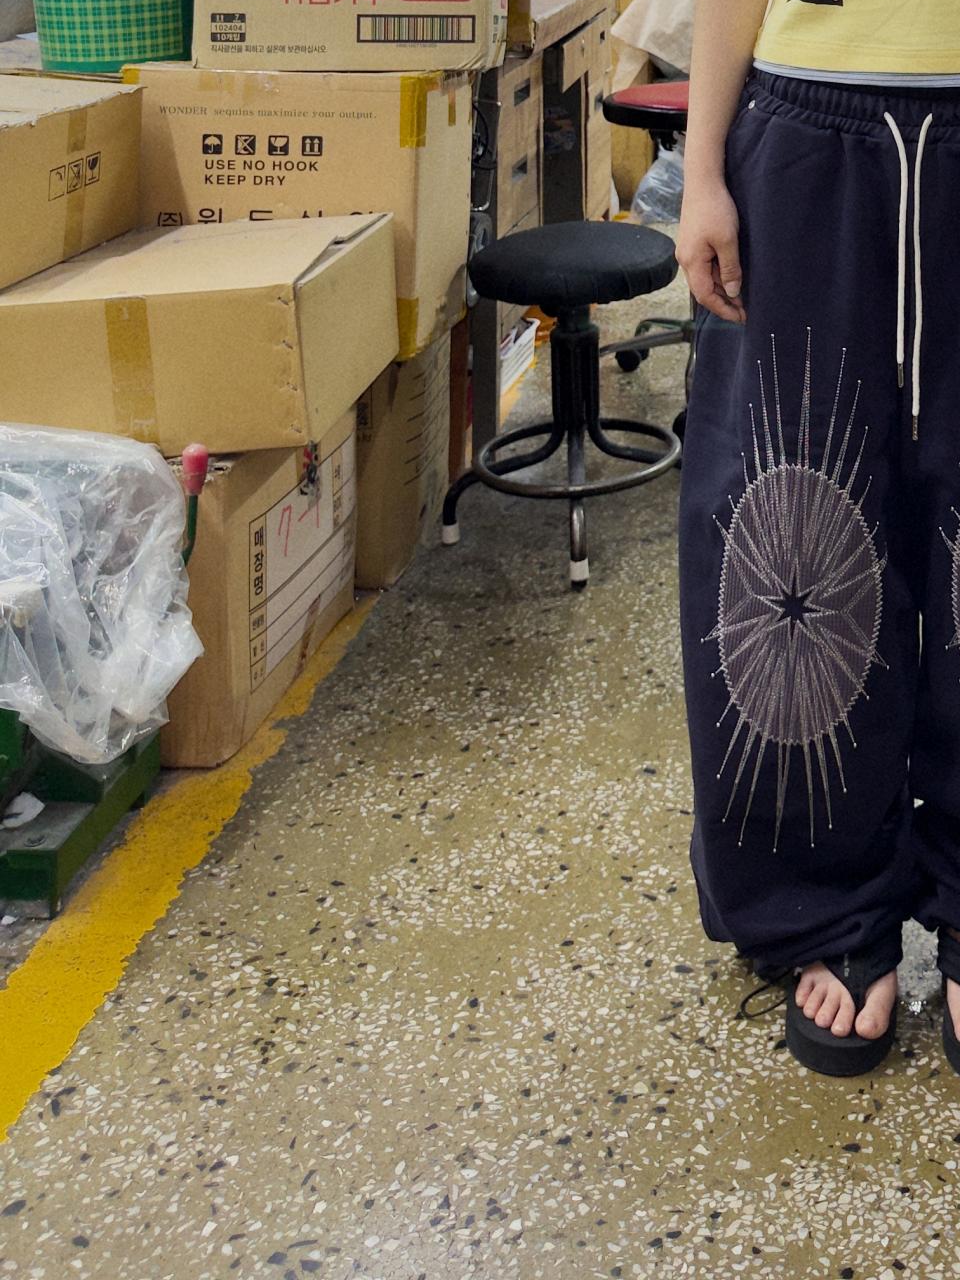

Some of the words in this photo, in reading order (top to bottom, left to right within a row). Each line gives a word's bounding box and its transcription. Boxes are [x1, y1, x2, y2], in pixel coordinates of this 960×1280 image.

[159, 105, 208, 116] WONDER
[214, 108, 254, 118] sequins
[257, 108, 309, 118] maximize
[312, 110, 335, 120] your
[339, 110, 377, 120] output.
[204, 159, 236, 170] USE
[243, 160, 265, 171] NO
[272, 161, 319, 172] HOOK
[204, 174, 247, 185] KEEP
[253, 175, 286, 186] DRY
